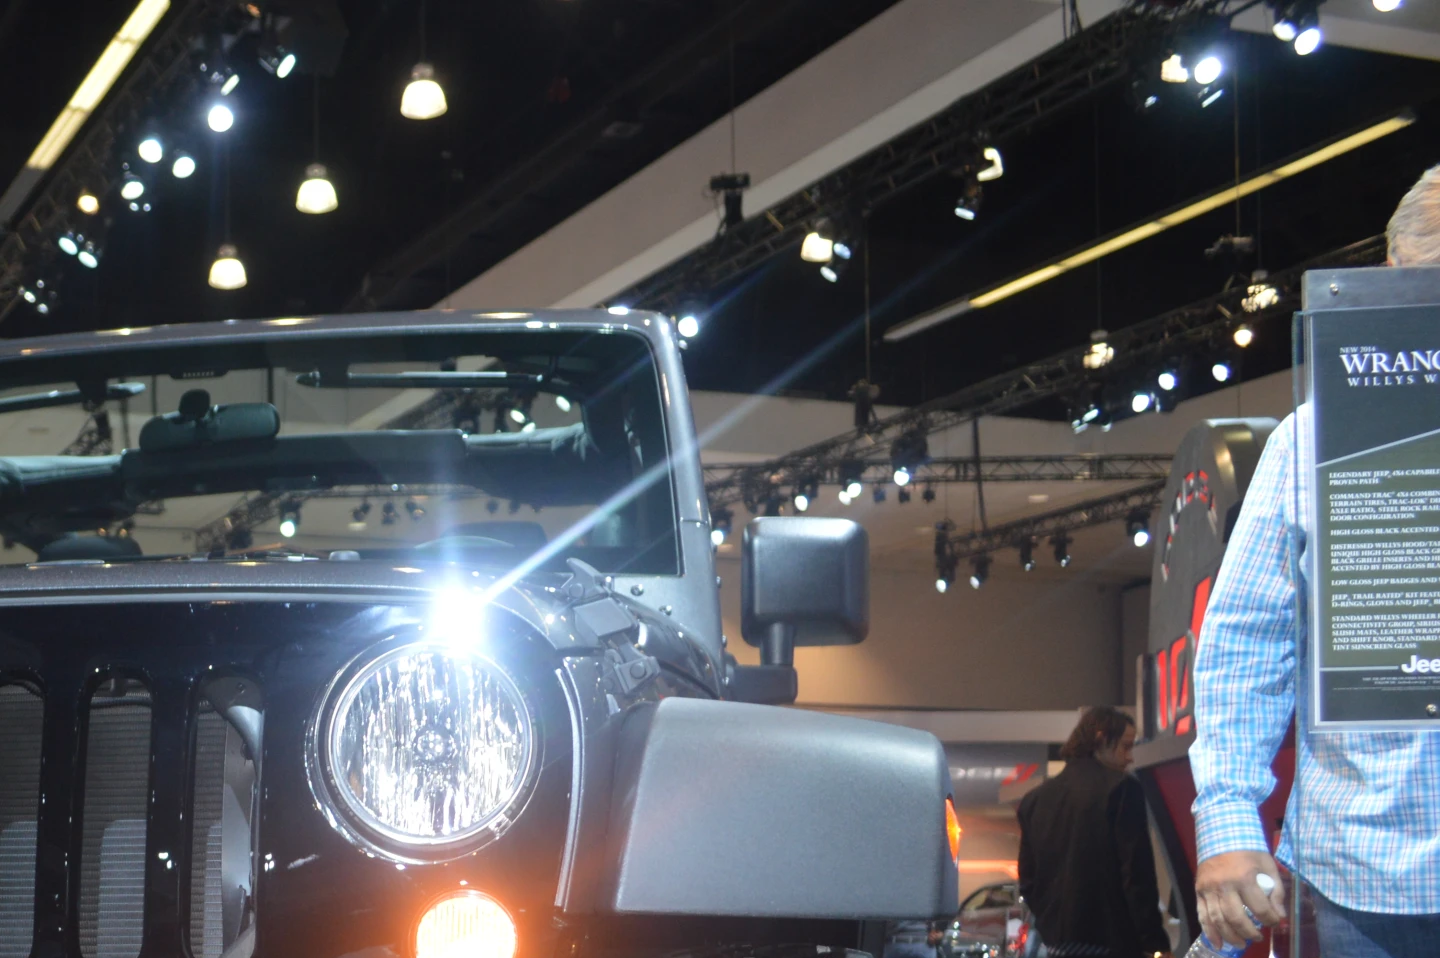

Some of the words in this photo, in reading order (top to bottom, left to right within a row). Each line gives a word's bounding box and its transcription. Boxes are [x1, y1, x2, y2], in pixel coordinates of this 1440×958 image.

[1347, 375, 1414, 387] WILLYS
[1424, 374, 1437, 383] W
[1329, 471, 1372, 479] LEGENDARY
[1329, 492, 1371, 500] COMMAND
[1375, 527, 1399, 535] BLACK
[1331, 550, 1360, 558] UNIQUE
[1373, 578, 1389, 586] JEEP
[1401, 655, 1440, 673] Jee
